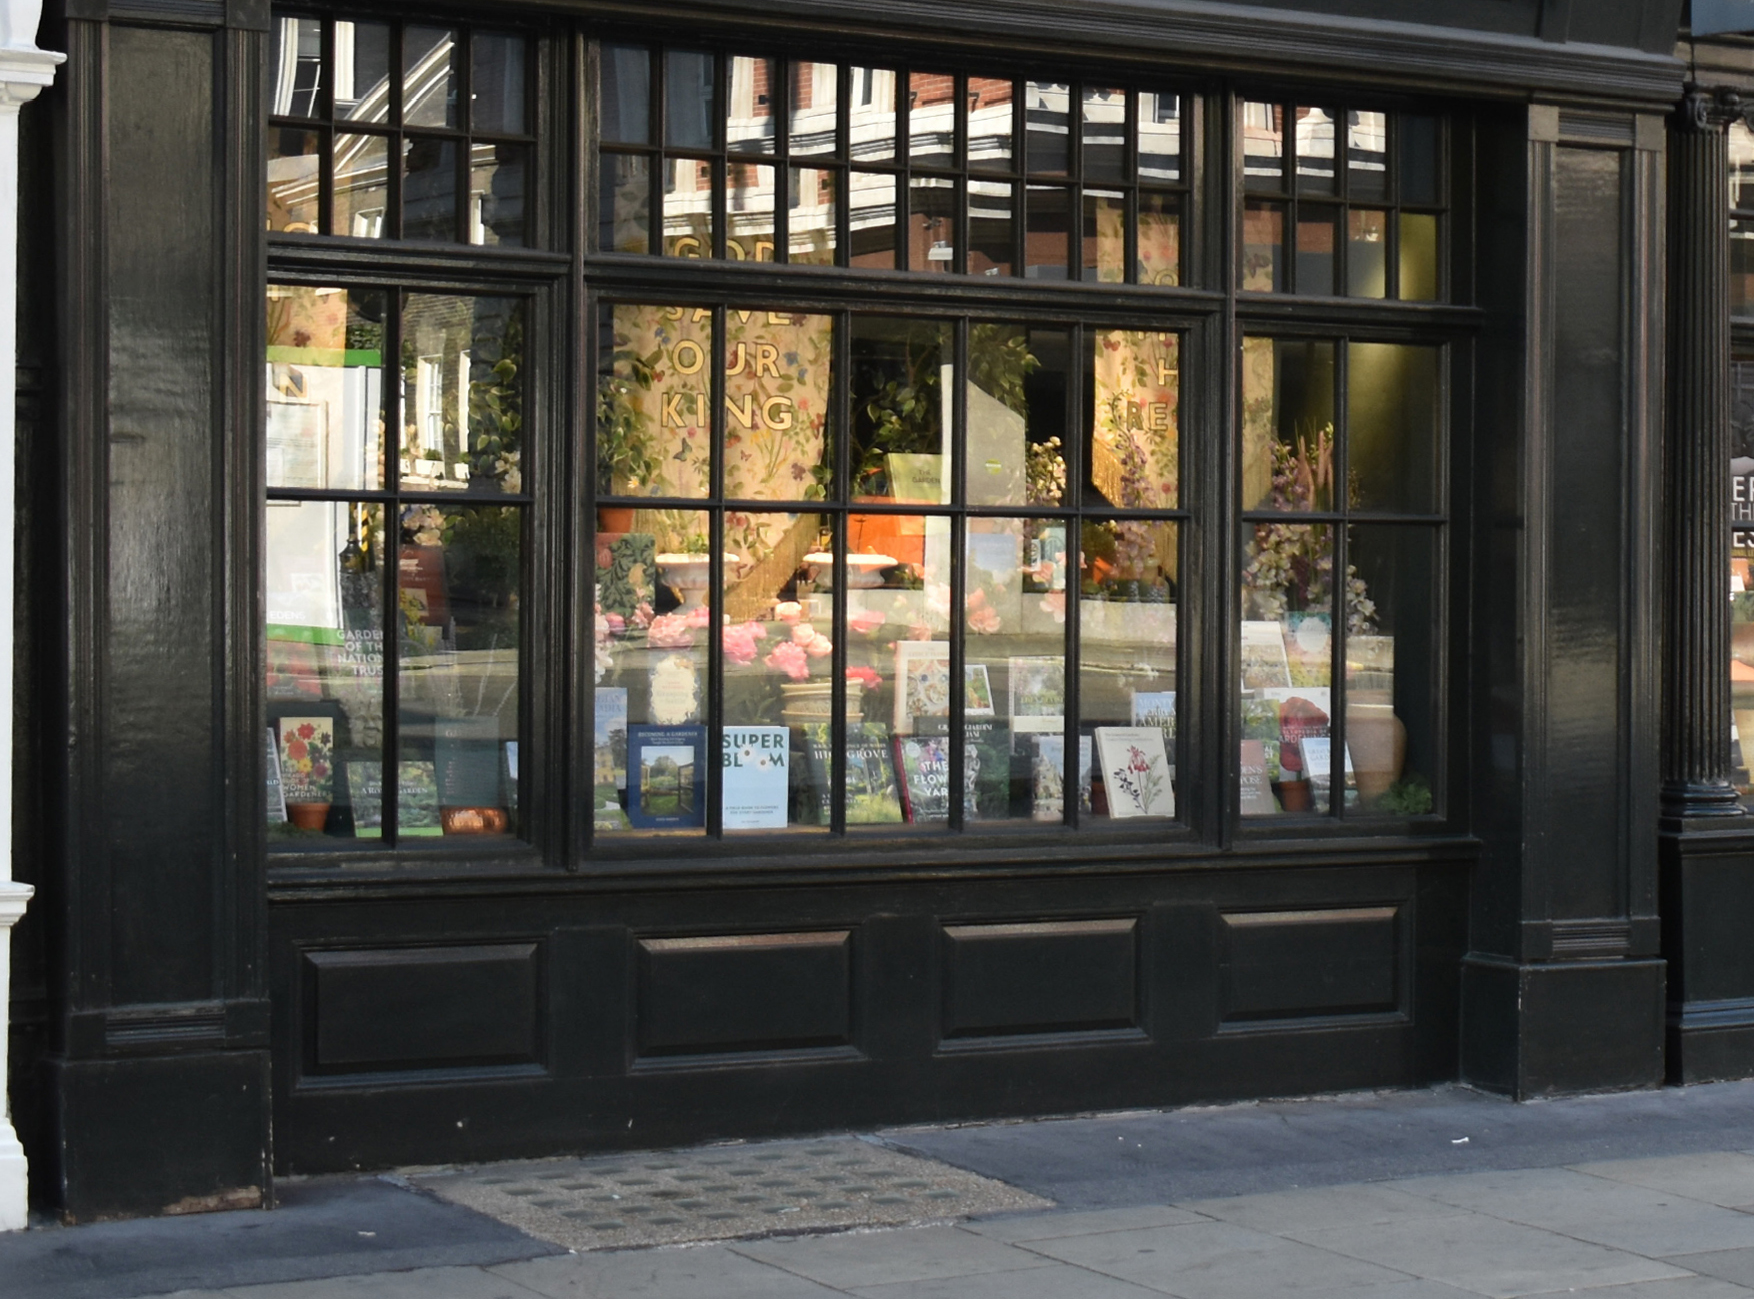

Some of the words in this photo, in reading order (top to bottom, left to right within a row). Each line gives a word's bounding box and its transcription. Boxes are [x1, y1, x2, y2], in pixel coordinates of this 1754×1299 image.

[672, 338, 780, 378] OUR
[661, 392, 793, 430] KING
[336, 629, 384, 640] GARDE
[344, 641, 361, 651] OF
[366, 641, 383, 651] TH
[337, 652, 383, 663] NATION
[351, 664, 383, 675] TRUS
[722, 734, 784, 749] SUPER
[846, 750, 888, 759] GROVE
[926, 761, 949, 771] THE
[914, 775, 949, 784] FLOW
[925, 788, 949, 797] YAR
